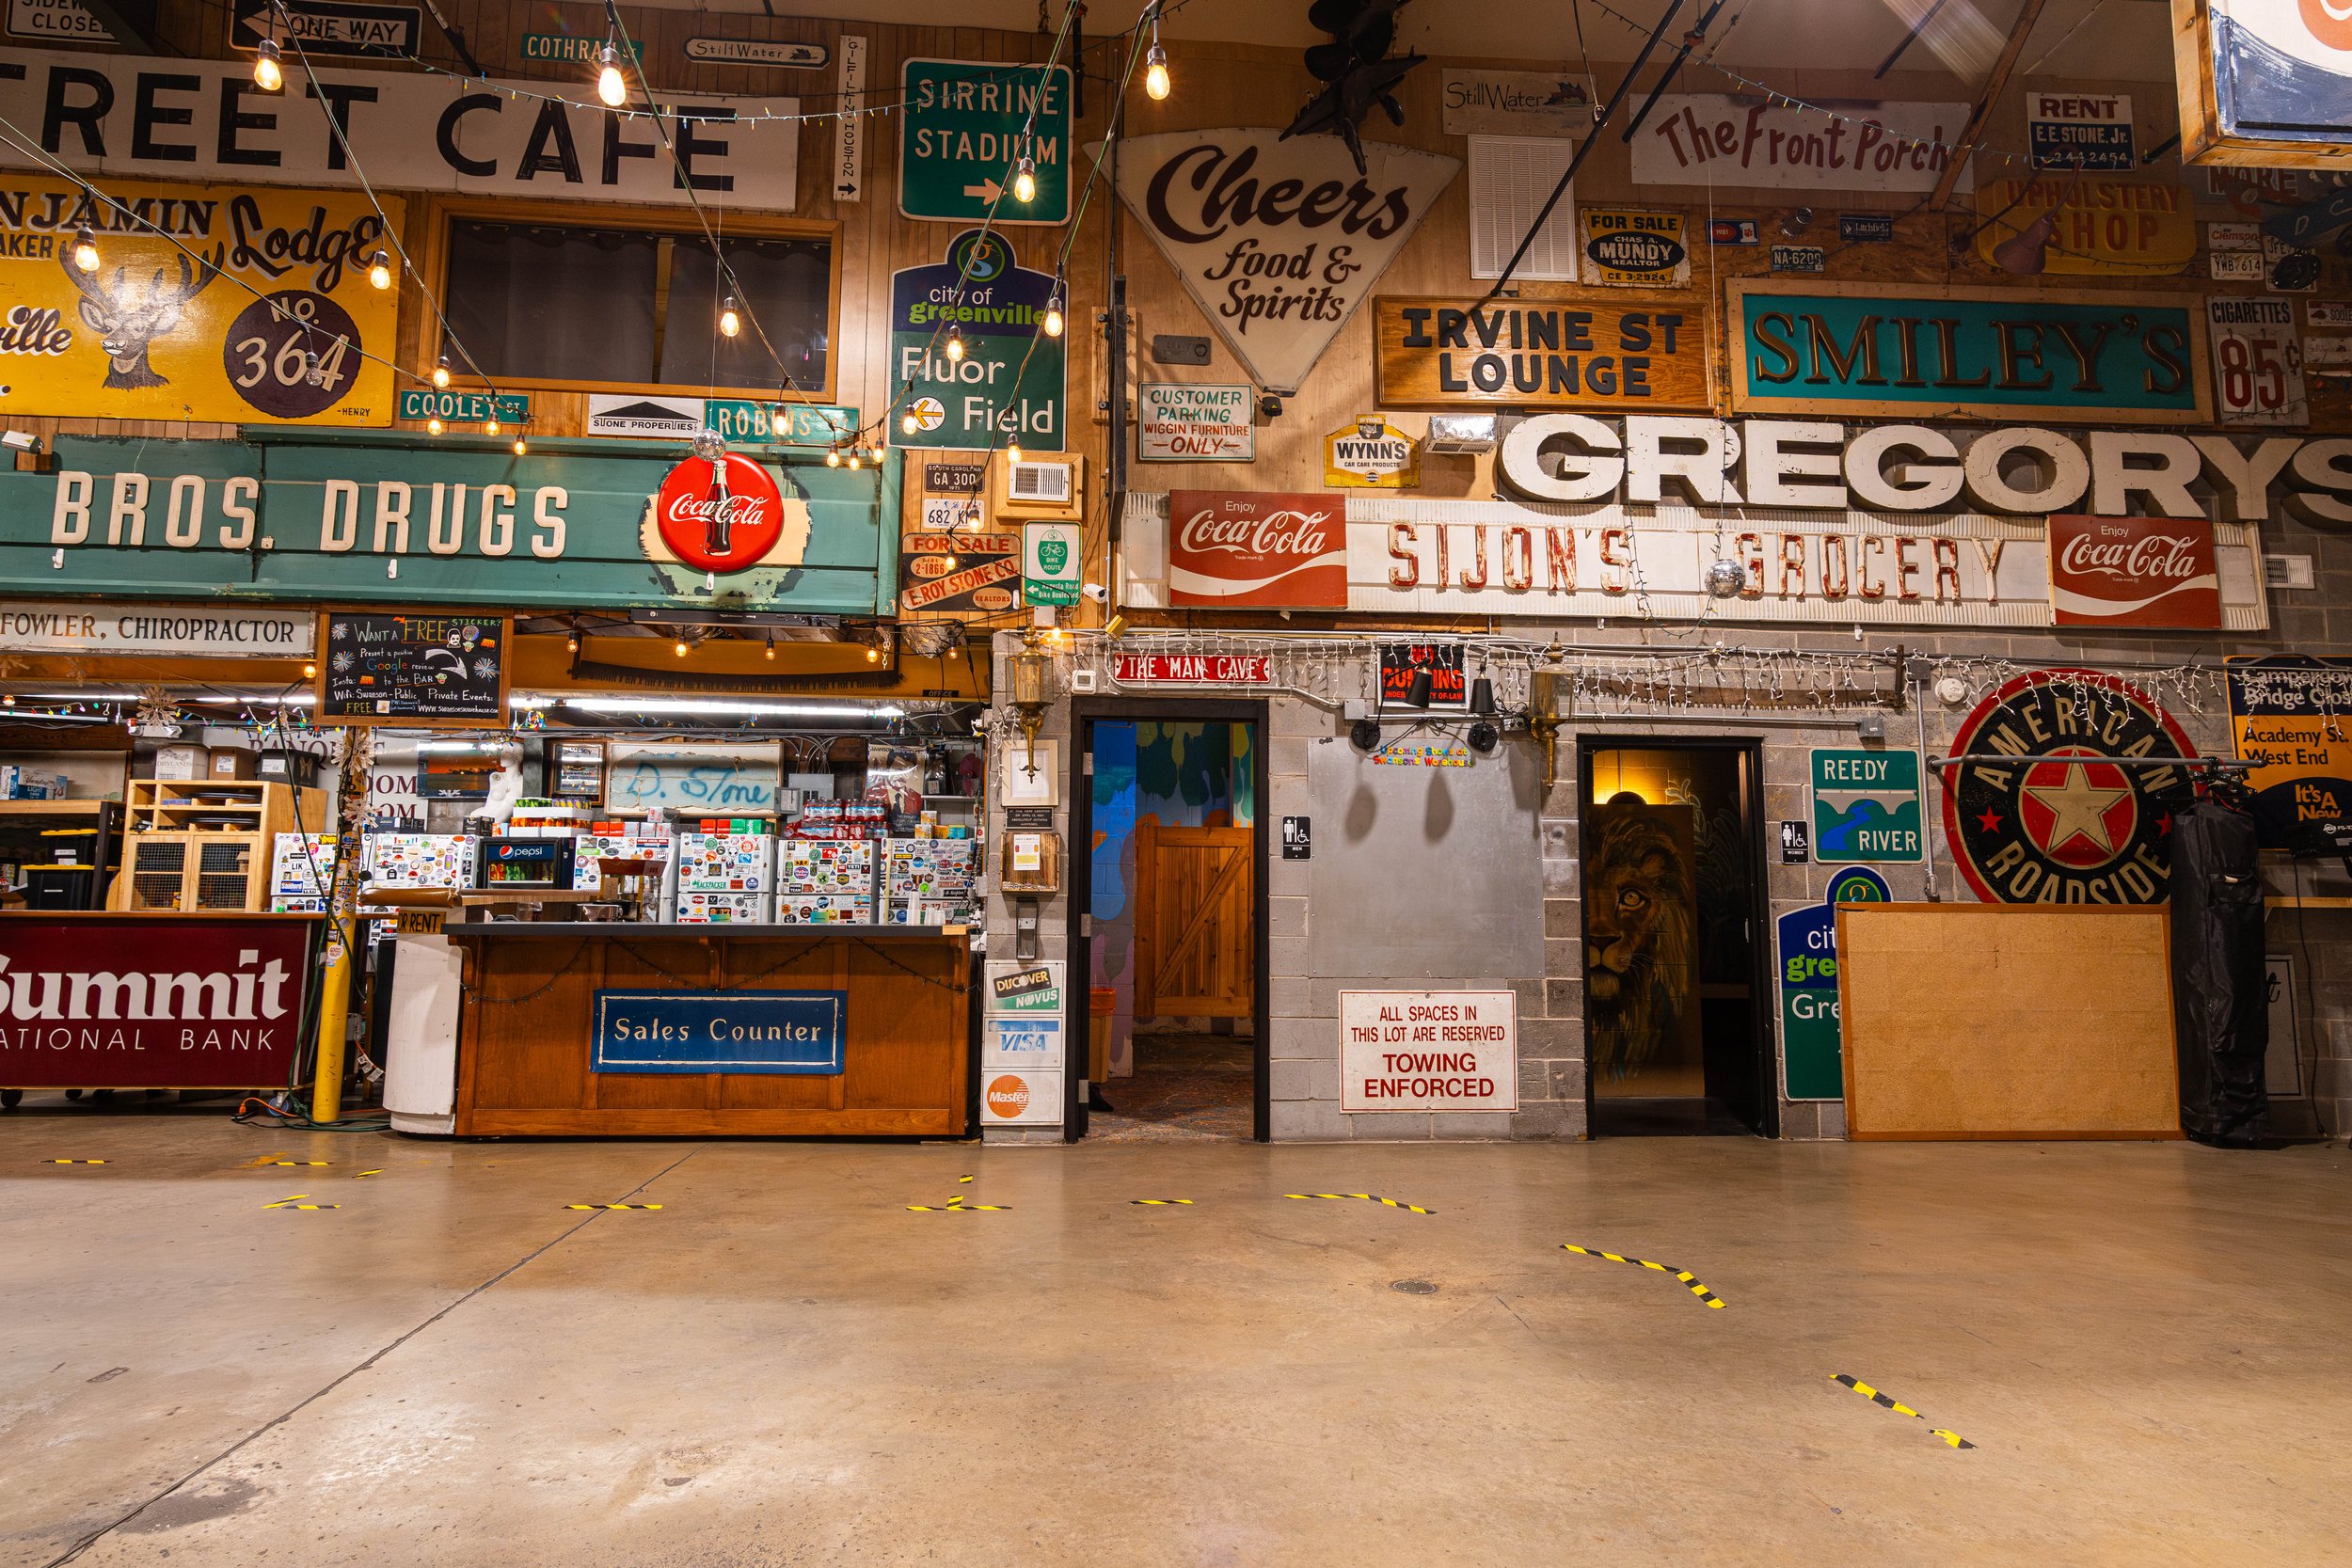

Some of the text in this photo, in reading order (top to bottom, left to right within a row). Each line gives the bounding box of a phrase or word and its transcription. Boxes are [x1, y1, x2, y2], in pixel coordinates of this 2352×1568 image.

[32, 12, 108, 33] CLOSE
[295, 16, 401, 44] ONE WAY
[528, 35, 617, 61] COTHRA
[916, 78, 1058, 115] SIRRINE
[2039, 97, 2119, 119] RENT
[436, 93, 737, 192] CAFE
[1656, 102, 1950, 173] The Front Porch
[2110, 127, 2128, 144] Jr.
[1146, 144, 1410, 245] Cheers
[2006, 179, 2179, 213] UPHOLSTERY
[1590, 214, 1677, 232] FOR SALE
[2048, 212, 2161, 252] SHOP
[1613, 235, 1645, 245] CHAS
[2212, 230, 2259, 242] Clemson
[1202, 238, 1361, 284] food &
[1599, 242, 1674, 261] MUNDY
[1612, 259, 1661, 268] REALTOR
[2215, 260, 2261, 272] YWB 614
[1607, 272, 1624, 281] CE
[930, 285, 993, 306] city of
[908, 301, 1048, 325] greenville
[1219, 278, 1345, 337] Spirits
[2211, 301, 2291, 325] CIGARETTES
[1402, 308, 1683, 355] IRVINE ST
[234, 330, 351, 393] 364
[1753, 309, 2186, 395] SMILEY'S
[900, 346, 1006, 385] Fluor
[1438, 352, 1652, 397] LOUNGE
[405, 392, 499, 419] COOLEY
[1150, 389, 1243, 405] CUSTOMER
[963, 395, 1054, 434] Field
[1156, 406, 1232, 423] PARKING
[1144, 423, 1250, 436] WIGGIN FURNITURE
[1170, 436, 1224, 454] ONLY
[1336, 440, 1406, 460] WYNN'S
[934, 472, 977, 486] GA 300
[50, 470, 569, 559] BROS. DRUGS
[928, 509, 950, 524] 682
[1225, 499, 1257, 514] Enjoy
[1180, 509, 1333, 556] Coca-Cola
[2100, 524, 2129, 538] Enjoy
[914, 537, 1009, 551] FOR SALE
[2060, 531, 2201, 578] Coca-Cola
[1388, 520, 1632, 594] SIJON'S
[1732, 531, 2007, 604] GROCERY
[915, 563, 945, 575] 2-1866
[951, 558, 1018, 594] STONE CO.
[975, 594, 1011, 603] REALTORS
[118, 615, 294, 643] CHIROPRACTOR
[404, 618, 449, 642] FREE
[366, 657, 408, 675] Google
[1126, 656, 1258, 681] THE MAN CAVE
[384, 673, 434, 686] to the BAR
[394, 688, 418, 700] Public
[428, 688, 458, 701] Private
[2245, 687, 2305, 710] Bridge
[346, 702, 372, 714] FREE
[1974, 696, 2178, 794] AMERICAN
[2243, 726, 2350, 747] Academy St.
[1373, 755, 1473, 768] Swansons Warehouse
[1379, 745, 1468, 758] Upcoming Shows at
[2244, 748, 2329, 766] West End
[1823, 759, 1889, 781] REEDY
[2295, 784, 2338, 810] It's A
[2298, 804, 2343, 822] New
[1857, 830, 1917, 852] RIVER
[514, 846, 543, 860] pepsi
[409, 912, 441, 933] RENT
[0, 948, 291, 1021] ummit
[995, 970, 1050, 992] DISCOVER
[1379, 1006, 1477, 1022] ALL SPACES IN
[180, 1028, 275, 1051] BANK
[614, 1017, 822, 1041] Sales Counter
[1351, 1025, 1505, 1042] THIS LOT ARE RESERVED
[1000, 1033, 1047, 1052] VISA
[1382, 1053, 1476, 1073] TOWING
[1364, 1077, 1495, 1099] ENFORCED
